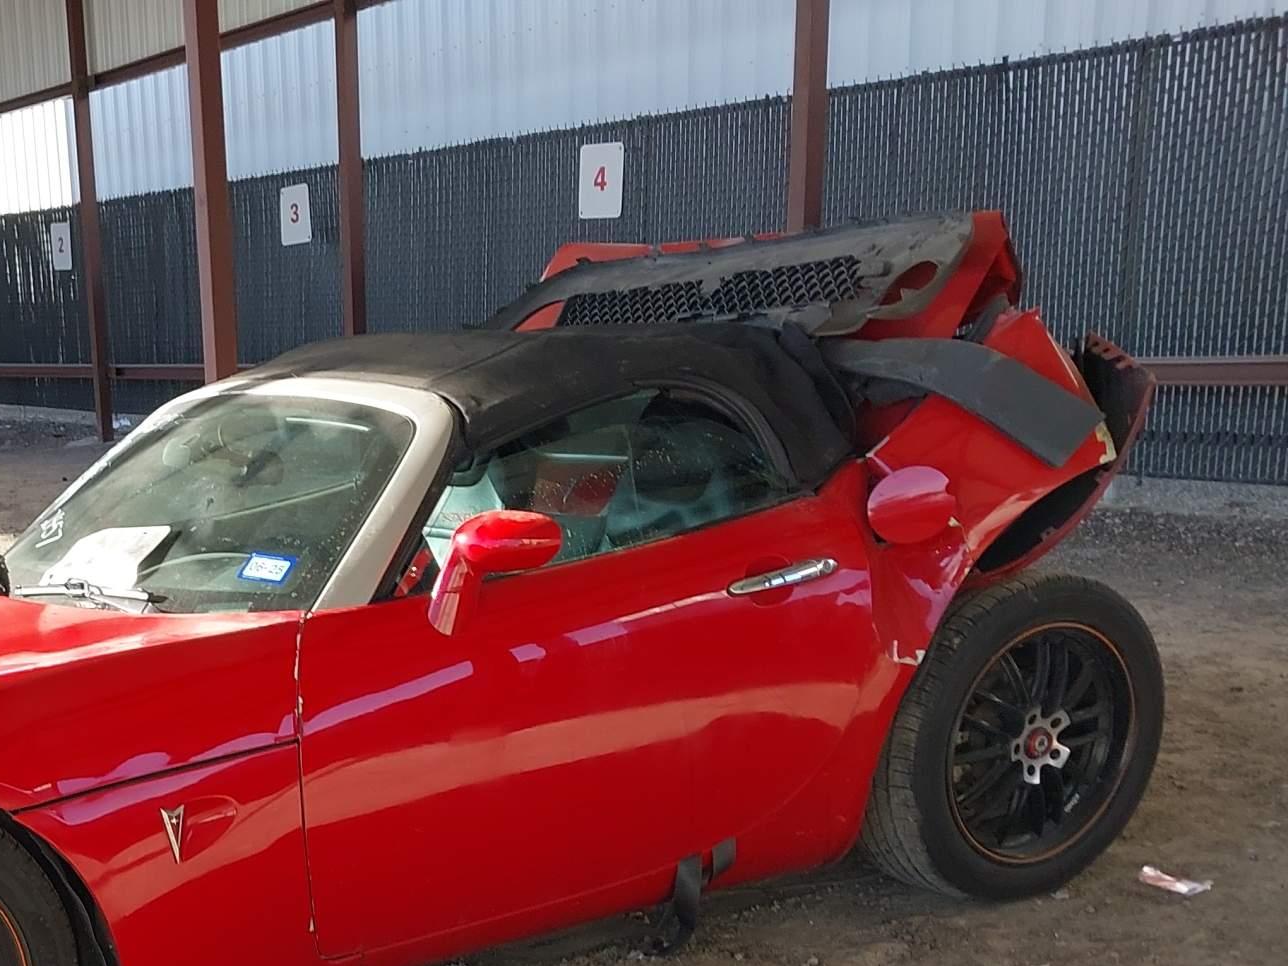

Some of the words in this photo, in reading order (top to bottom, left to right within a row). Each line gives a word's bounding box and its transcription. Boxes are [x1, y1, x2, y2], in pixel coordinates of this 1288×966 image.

[593, 166, 607, 192] 4
[290, 203, 300, 224] 3
[58, 236, 65, 254] 2
